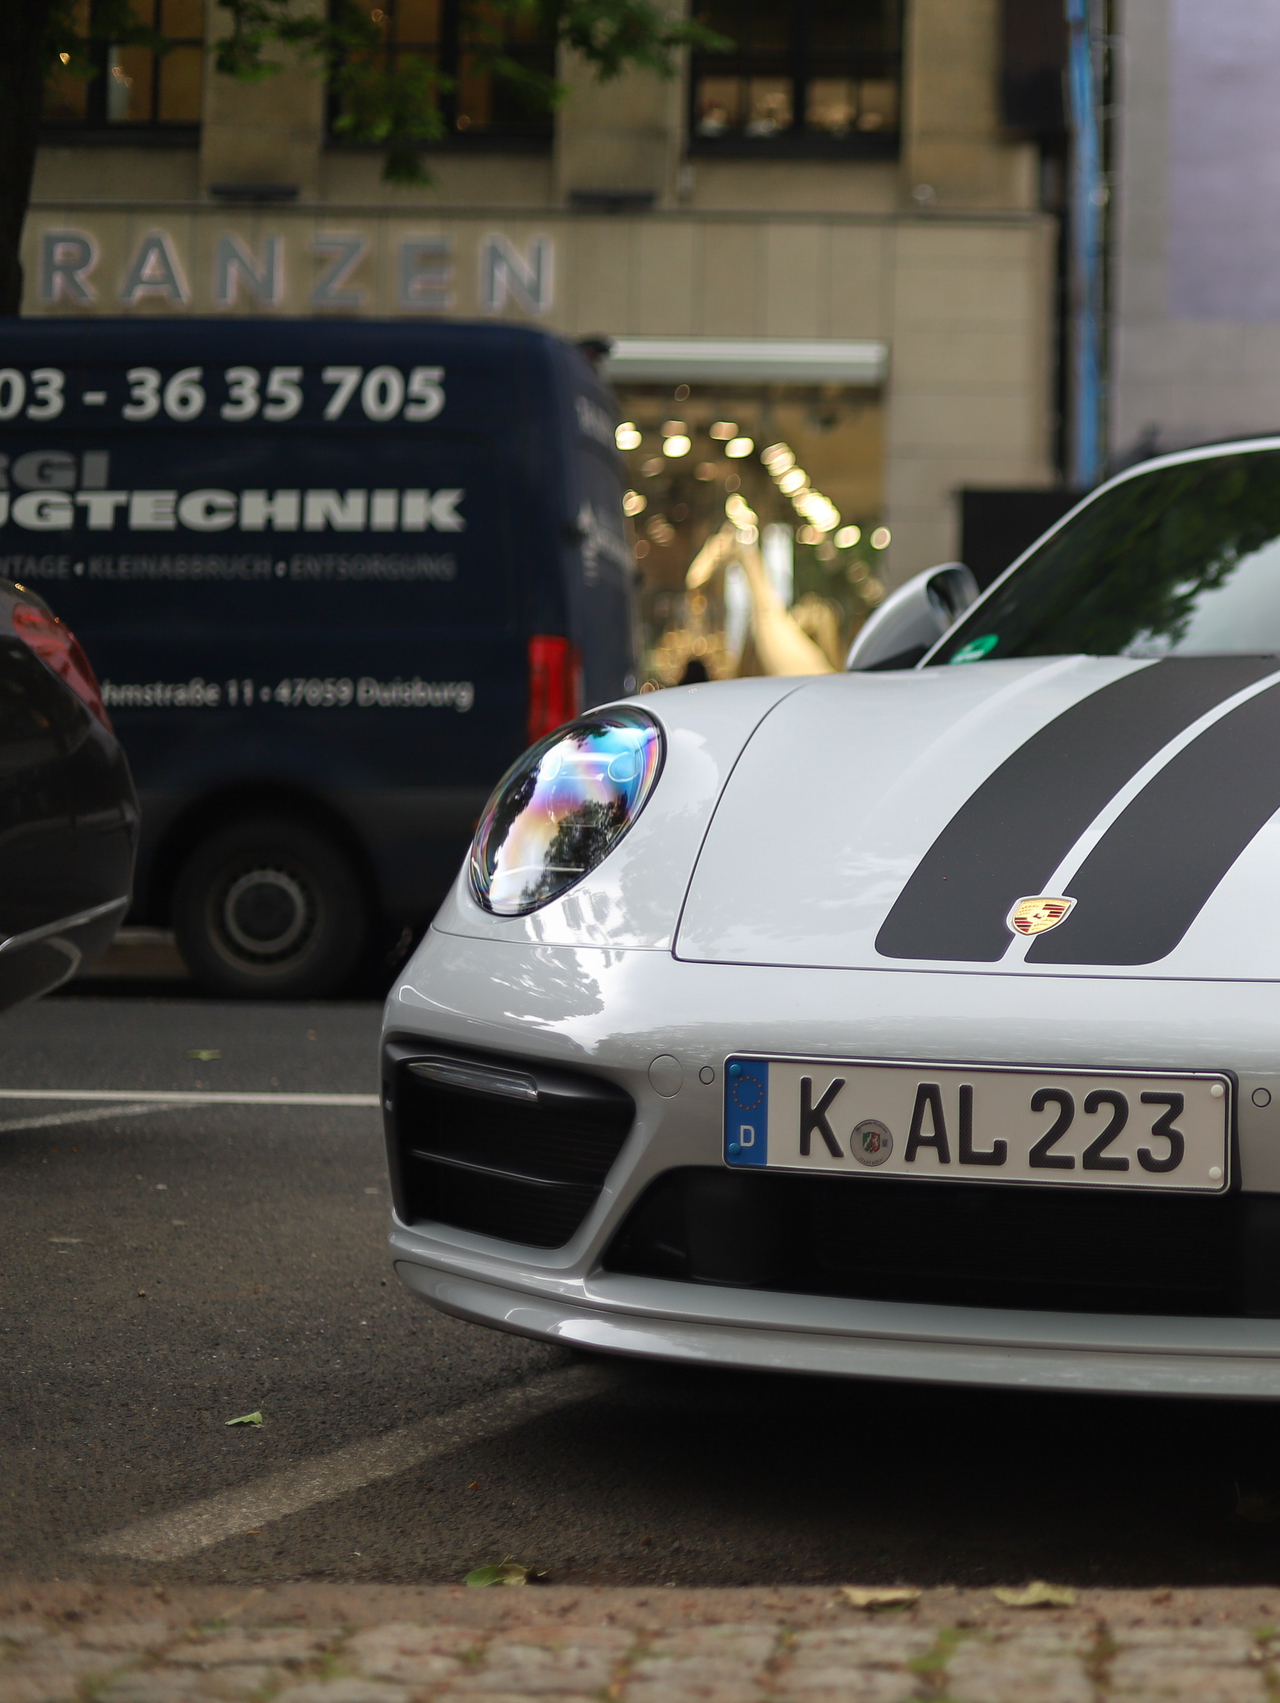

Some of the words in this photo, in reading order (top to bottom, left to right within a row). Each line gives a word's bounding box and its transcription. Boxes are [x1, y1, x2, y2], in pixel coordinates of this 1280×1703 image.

[122, 366, 206, 421] 36
[219, 366, 304, 421] 35
[321, 366, 446, 421] 705
[0, 449, 111, 490] GI
[0, 488, 467, 532] GTECHNIK
[226, 677, 254, 707] 11
[356, 675, 475, 713] Duisburg
[739, 1124, 755, 1148] D
[799, 1076, 846, 1158] K
[903, 1082, 1008, 1166] AL
[1028, 1087, 1185, 1173] 223
